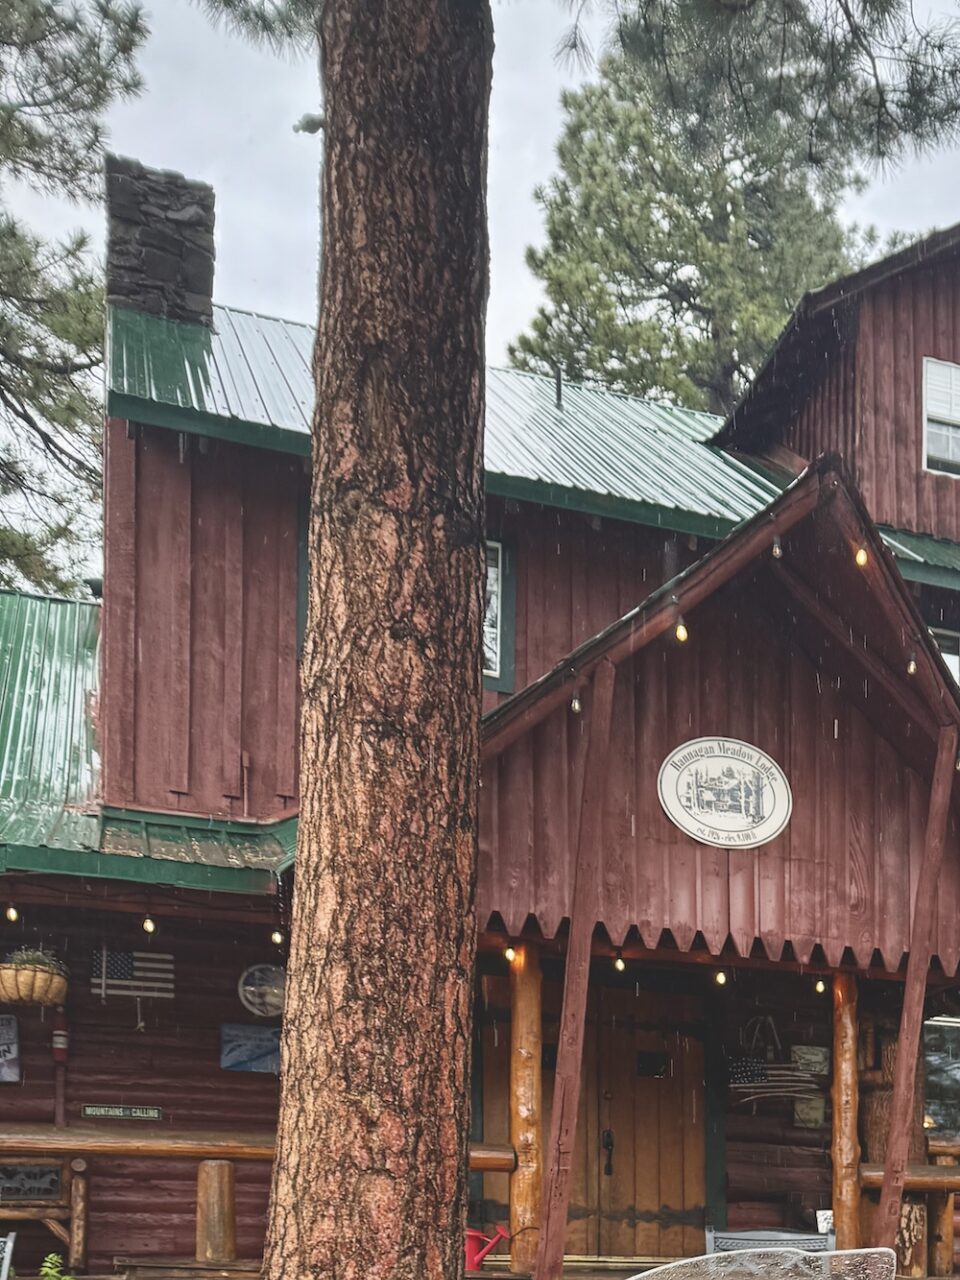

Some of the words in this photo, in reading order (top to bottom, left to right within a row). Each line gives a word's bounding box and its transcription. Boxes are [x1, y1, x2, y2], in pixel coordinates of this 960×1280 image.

[670, 745, 715, 772] Hannagan
[717, 742, 753, 762] Meadow
[755, 756, 779, 782] Lodge
[85, 1106, 123, 1116] MOUNTAINS
[131, 1108, 159, 1118] CALLING
